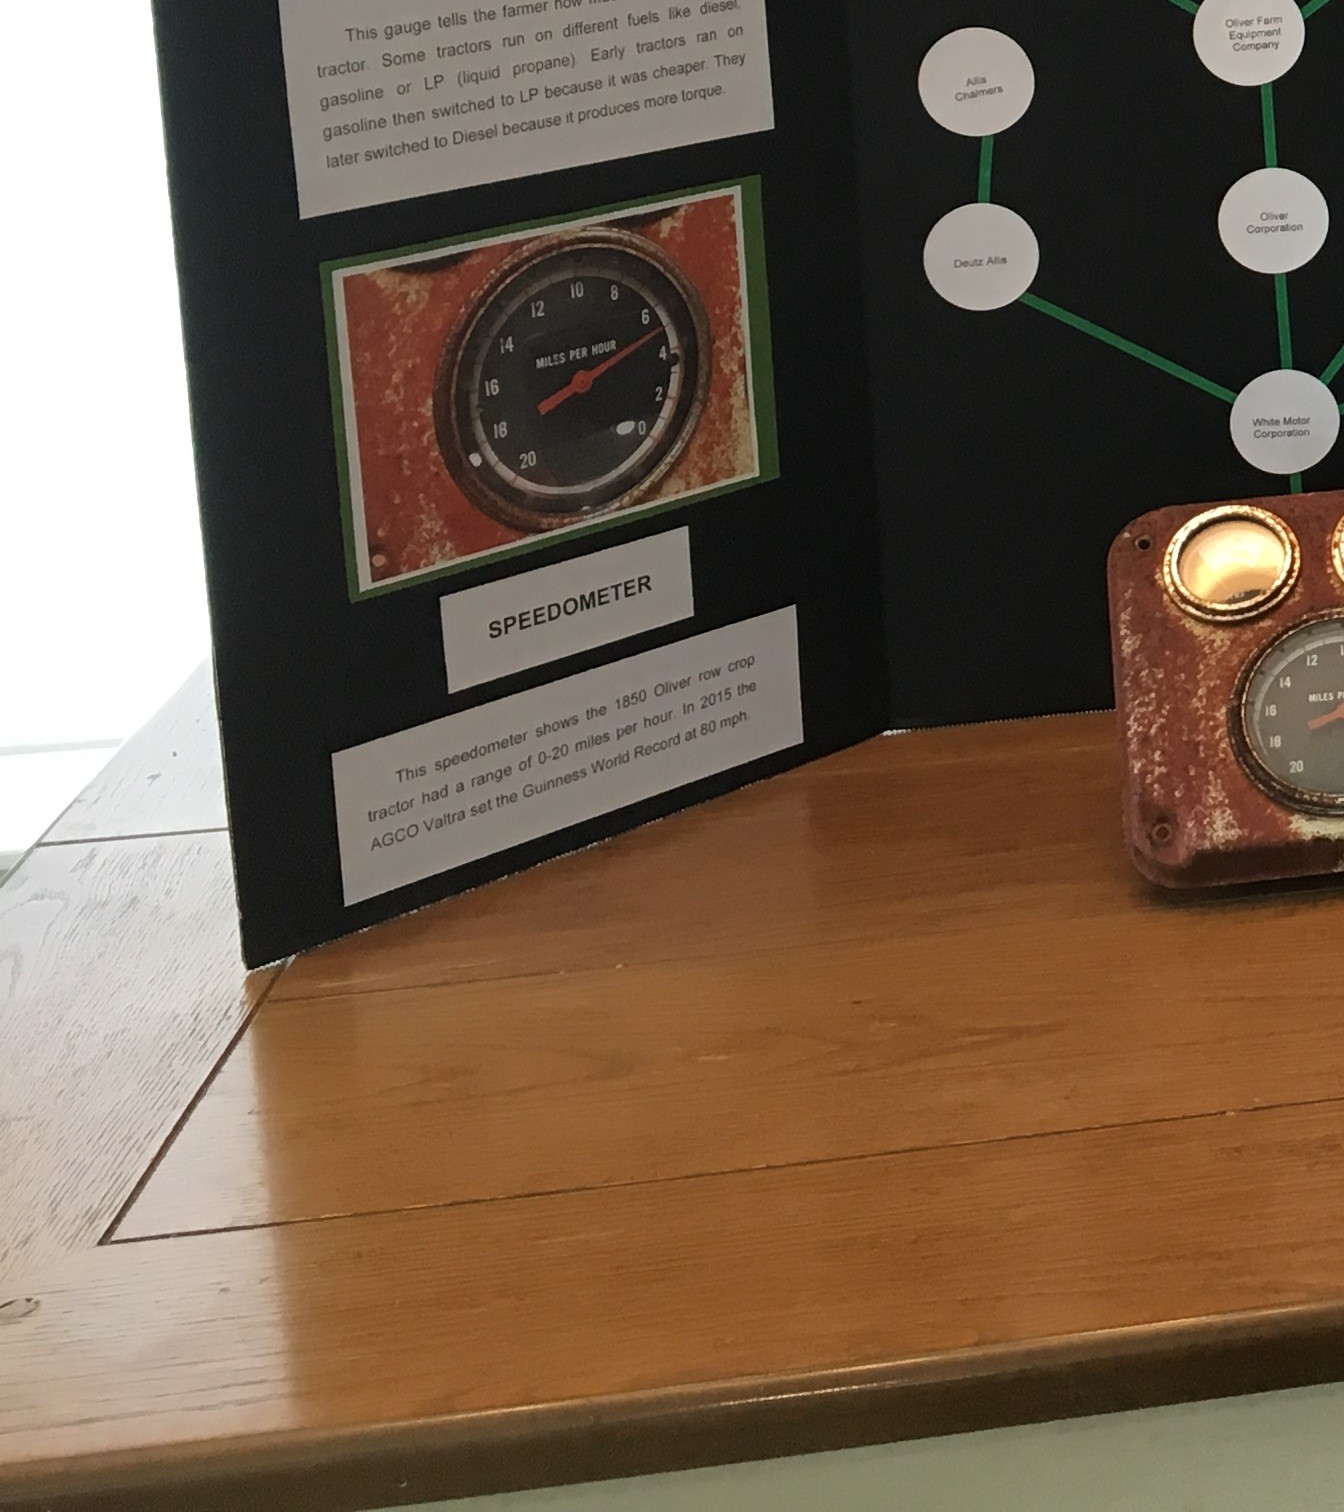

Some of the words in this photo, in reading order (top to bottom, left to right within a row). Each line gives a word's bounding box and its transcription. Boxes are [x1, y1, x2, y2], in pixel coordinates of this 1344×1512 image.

[1225, 19, 1254, 28] Oliver
[1257, 16, 1282, 24] Farm
[1229, 28, 1281, 41] Equipment
[1232, 41, 1279, 51] Company
[966, 76, 987, 87] Allis
[954, 86, 1003, 102] Chalmers
[325, 151, 360, 169] later
[363, 136, 430, 162] switched
[433, 135, 448, 149] to
[452, 123, 499, 145] Diesel
[501, 114, 562, 136] because
[565, 110, 575, 124] it
[577, 100, 641, 124] produces
[643, 93, 678, 109] more
[1260, 211, 1288, 221] Oliver
[1246, 223, 1303, 234] Corporation
[986, 256, 1007, 265] Allis
[570, 282, 584, 298] 10
[530, 300, 544, 318] 12
[500, 336, 514, 354] 14
[536, 352, 566, 369] MILES
[570, 348, 588, 360] PER
[592, 340, 616, 355] HOUR
[484, 379, 500, 396] 16
[1252, 417, 1280, 426] White
[1283, 416, 1310, 425] Motor
[494, 422, 508, 438] 18
[1254, 428, 1310, 439] Corporation
[519, 450, 536, 470] 20
[488, 575, 652, 640] SPEEDOMETER
[1306, 654, 1318, 666] 12
[1308, 691, 1334, 702] MILES
[394, 765, 427, 784] This
[434, 730, 528, 772] speedometer
[534, 714, 579, 738] shows
[585, 705, 608, 721] the
[614, 688, 647, 710] 1850
[653, 675, 692, 697] Oliver
[698, 666, 722, 682] row
[727, 654, 755, 673] crop
[1290, 760, 1304, 774] 20
